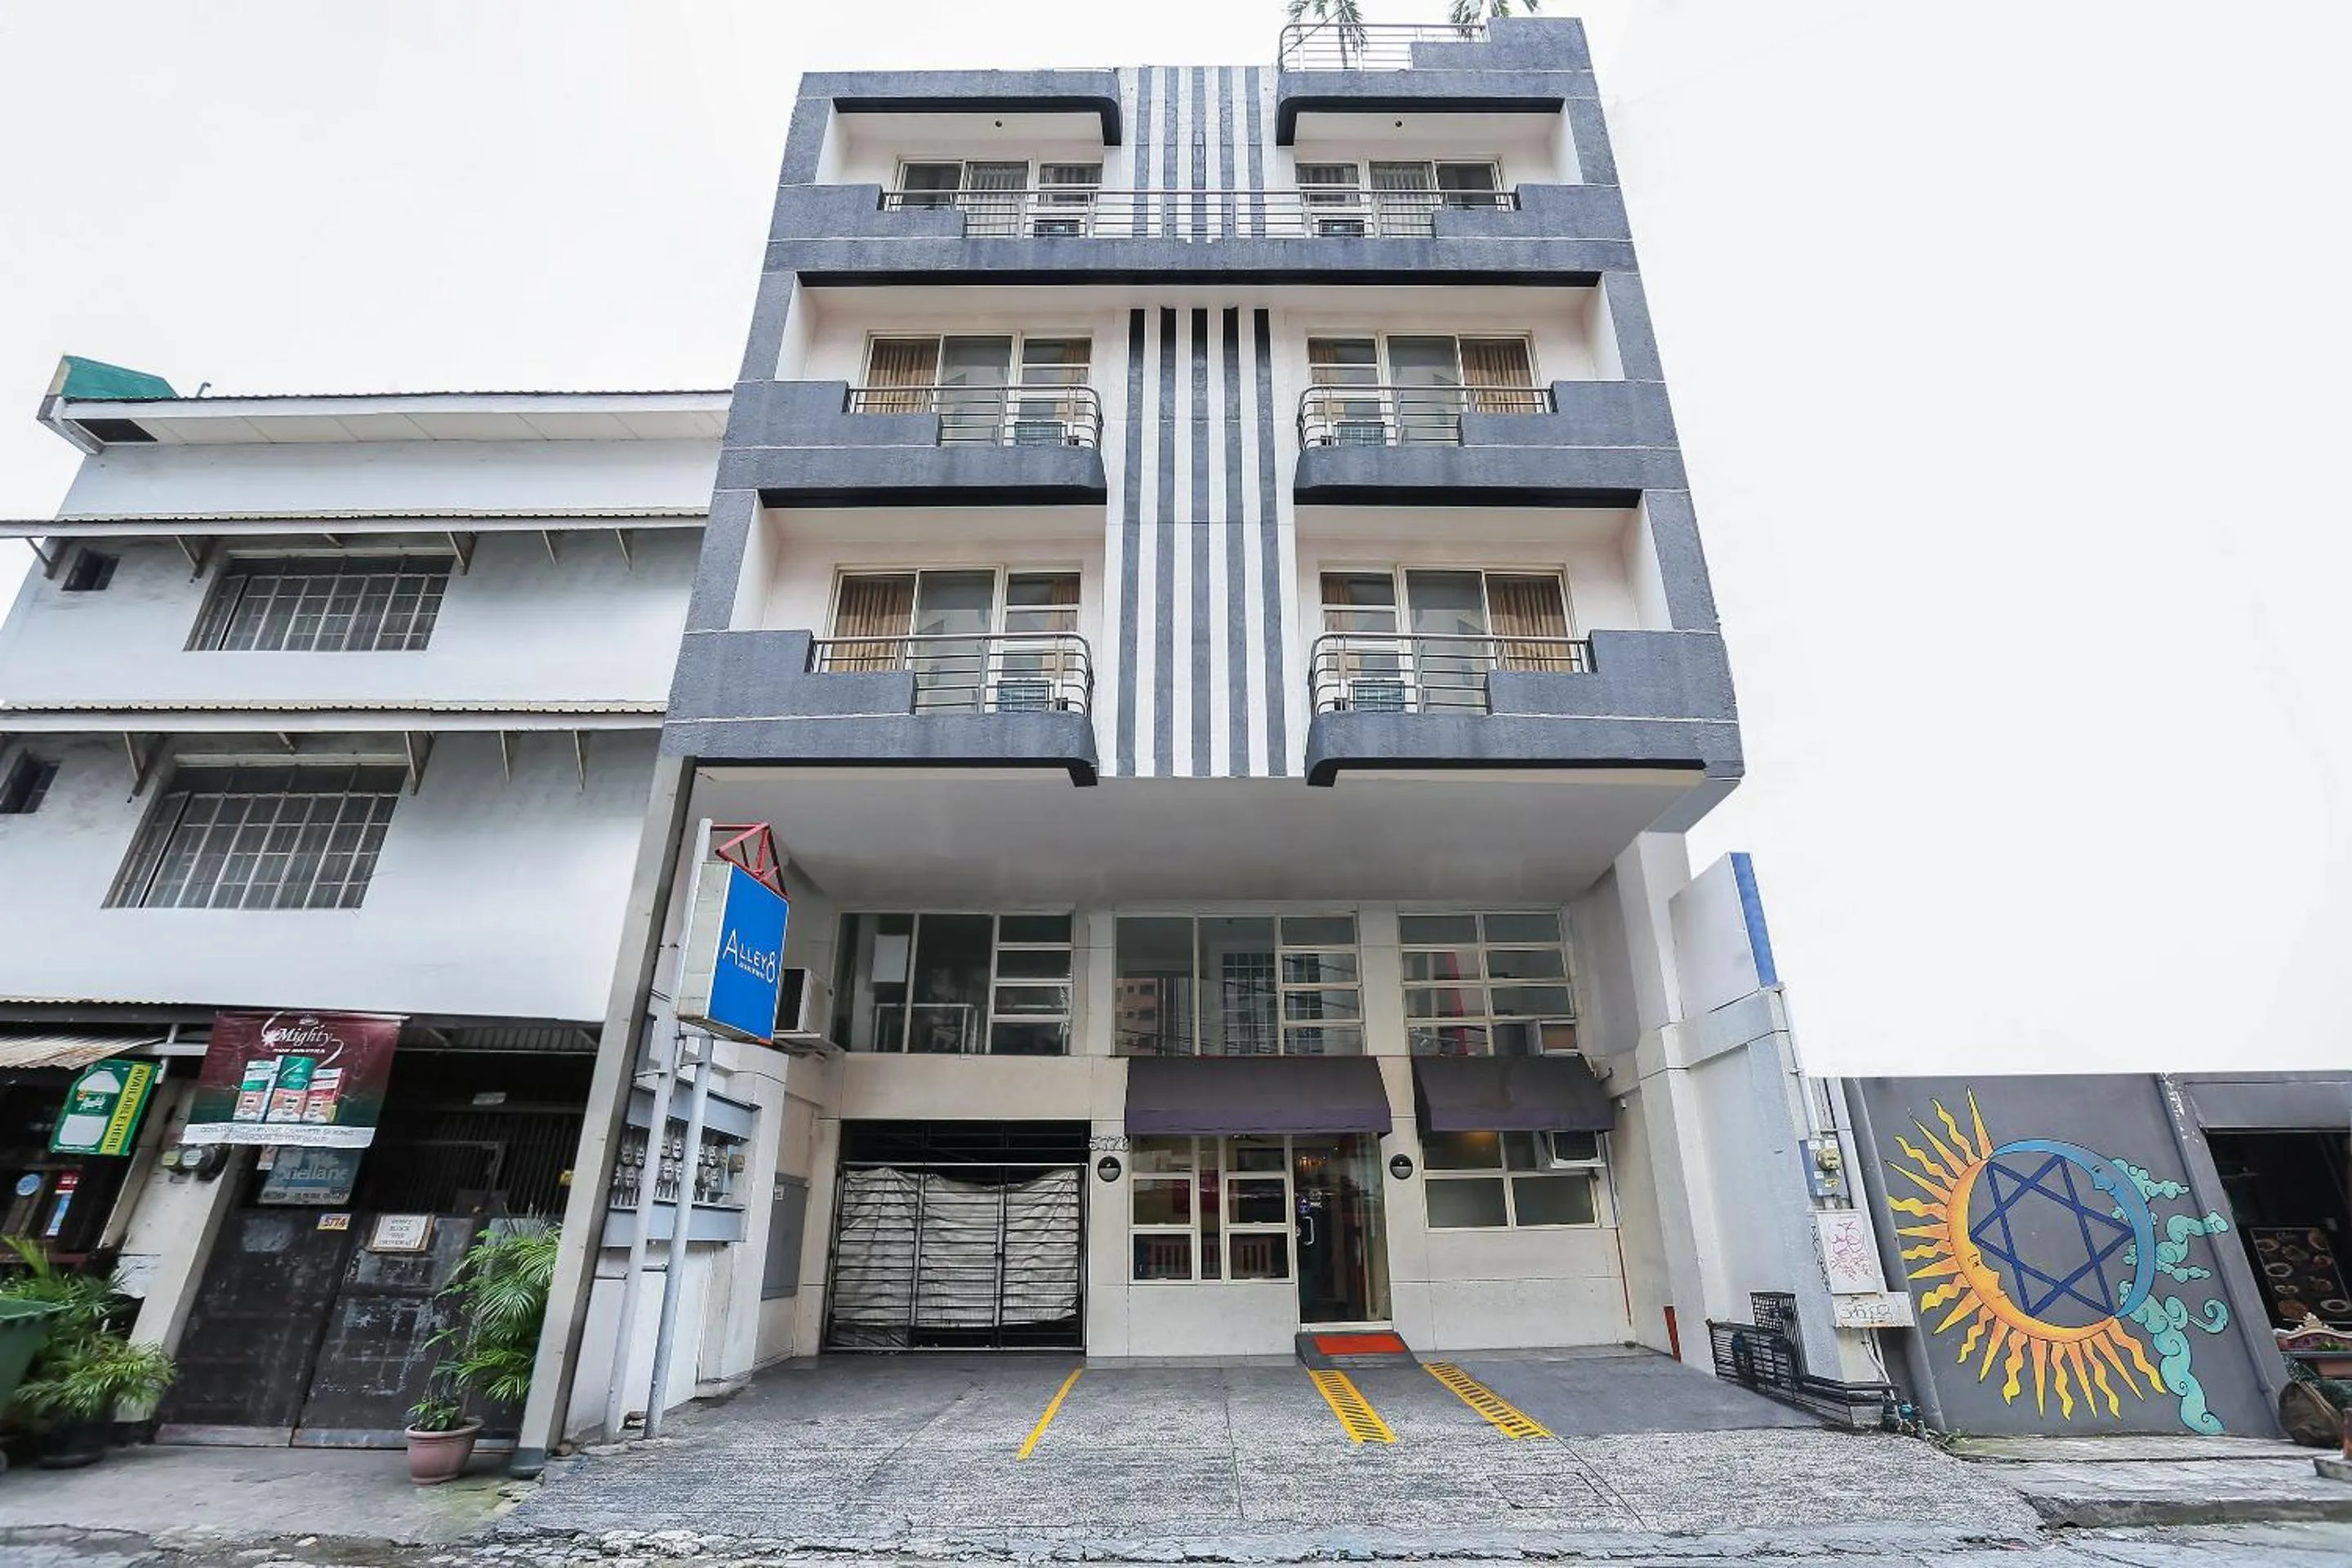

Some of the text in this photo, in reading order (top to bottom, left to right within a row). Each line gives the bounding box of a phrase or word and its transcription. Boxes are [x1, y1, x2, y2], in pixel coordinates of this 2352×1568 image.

[276, 1026, 333, 1047] Mighty
[106, 1068, 145, 1151] AVAILABLE HERE
